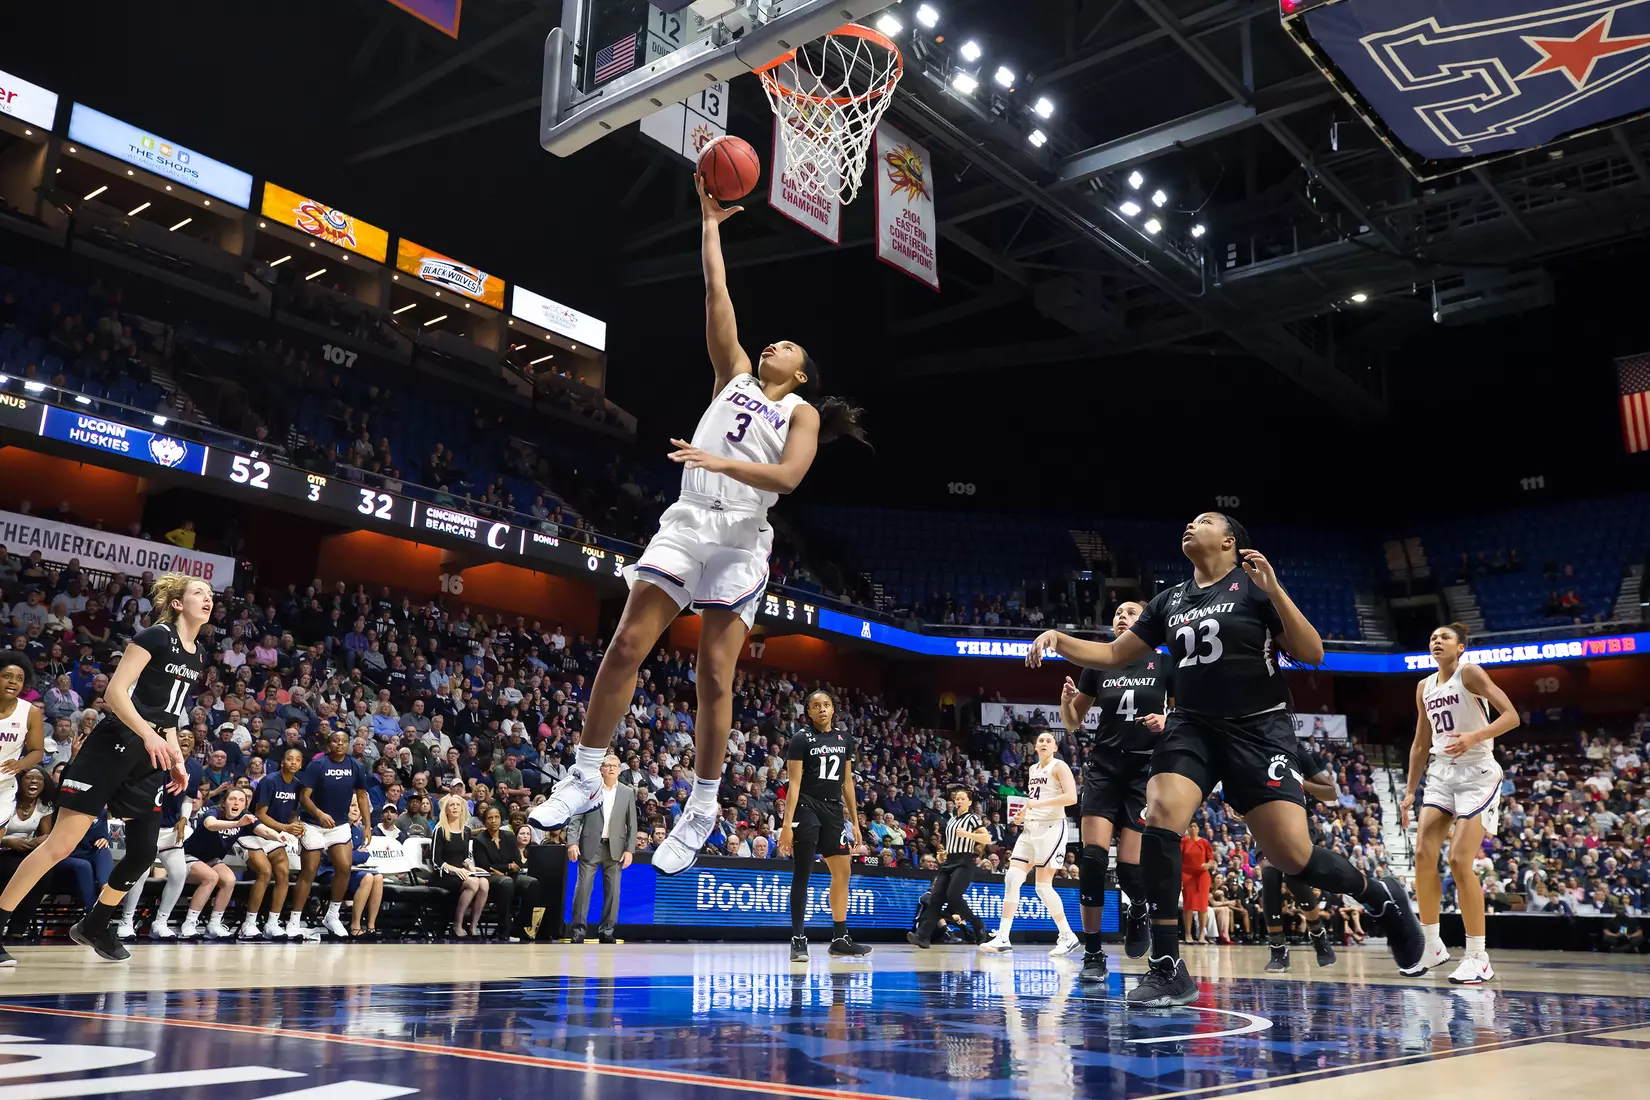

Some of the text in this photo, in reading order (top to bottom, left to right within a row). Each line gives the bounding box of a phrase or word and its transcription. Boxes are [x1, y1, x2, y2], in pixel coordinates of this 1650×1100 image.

[660, 11, 680, 43] 12
[129, 144, 199, 178] THE SHOPS
[782, 187, 829, 226] CHAMPIONS
[895, 217, 927, 243] EASTERN
[890, 224, 934, 260] CONFERENCE
[892, 238, 933, 271] CHAMPIONS
[322, 344, 358, 369] 107
[77, 416, 127, 439] UCONN
[726, 413, 752, 443] 3
[69, 427, 130, 453] HUSKIES
[229, 455, 271, 490] 52
[307, 474, 327, 487] QTR
[1520, 475, 1545, 490] 111
[307, 484, 321, 502] 3
[947, 481, 976, 496] 109
[357, 488, 393, 520] 32
[1215, 495, 1240, 508] 110
[425, 518, 477, 540] BEARCATS
[426, 507, 478, 529] CINCINNATI
[533, 533, 559, 548] BONUS
[582, 546, 605, 559] FOULS
[587, 556, 599, 571] 0
[615, 554, 625, 564] TO
[613, 563, 624, 578] 3
[439, 573, 464, 596] 16
[764, 601, 780, 617] 23
[786, 607, 795, 620] 3
[806, 611, 812, 625] 1
[1168, 602, 1236, 628] CINCINNATI
[749, 642, 766, 659] 17
[1175, 618, 1224, 669] 23
[1404, 637, 1636, 670] THEMERICAN.ORG/WBB
[1102, 676, 1157, 688] CINCINNATI
[1535, 677, 1560, 693] 19
[164, 679, 191, 717] 11
[1116, 689, 1139, 722] 4
[1431, 710, 1455, 734] 20
[810, 745, 846, 756] CINCINNATI
[817, 755, 841, 781] 12
[1028, 777, 1048, 786] CONN
[275, 791, 297, 800] UCONN
[1029, 786, 1041, 801] 24
[864, 856, 879, 865] POSS
[696, 872, 875, 921] Bookin.cm
